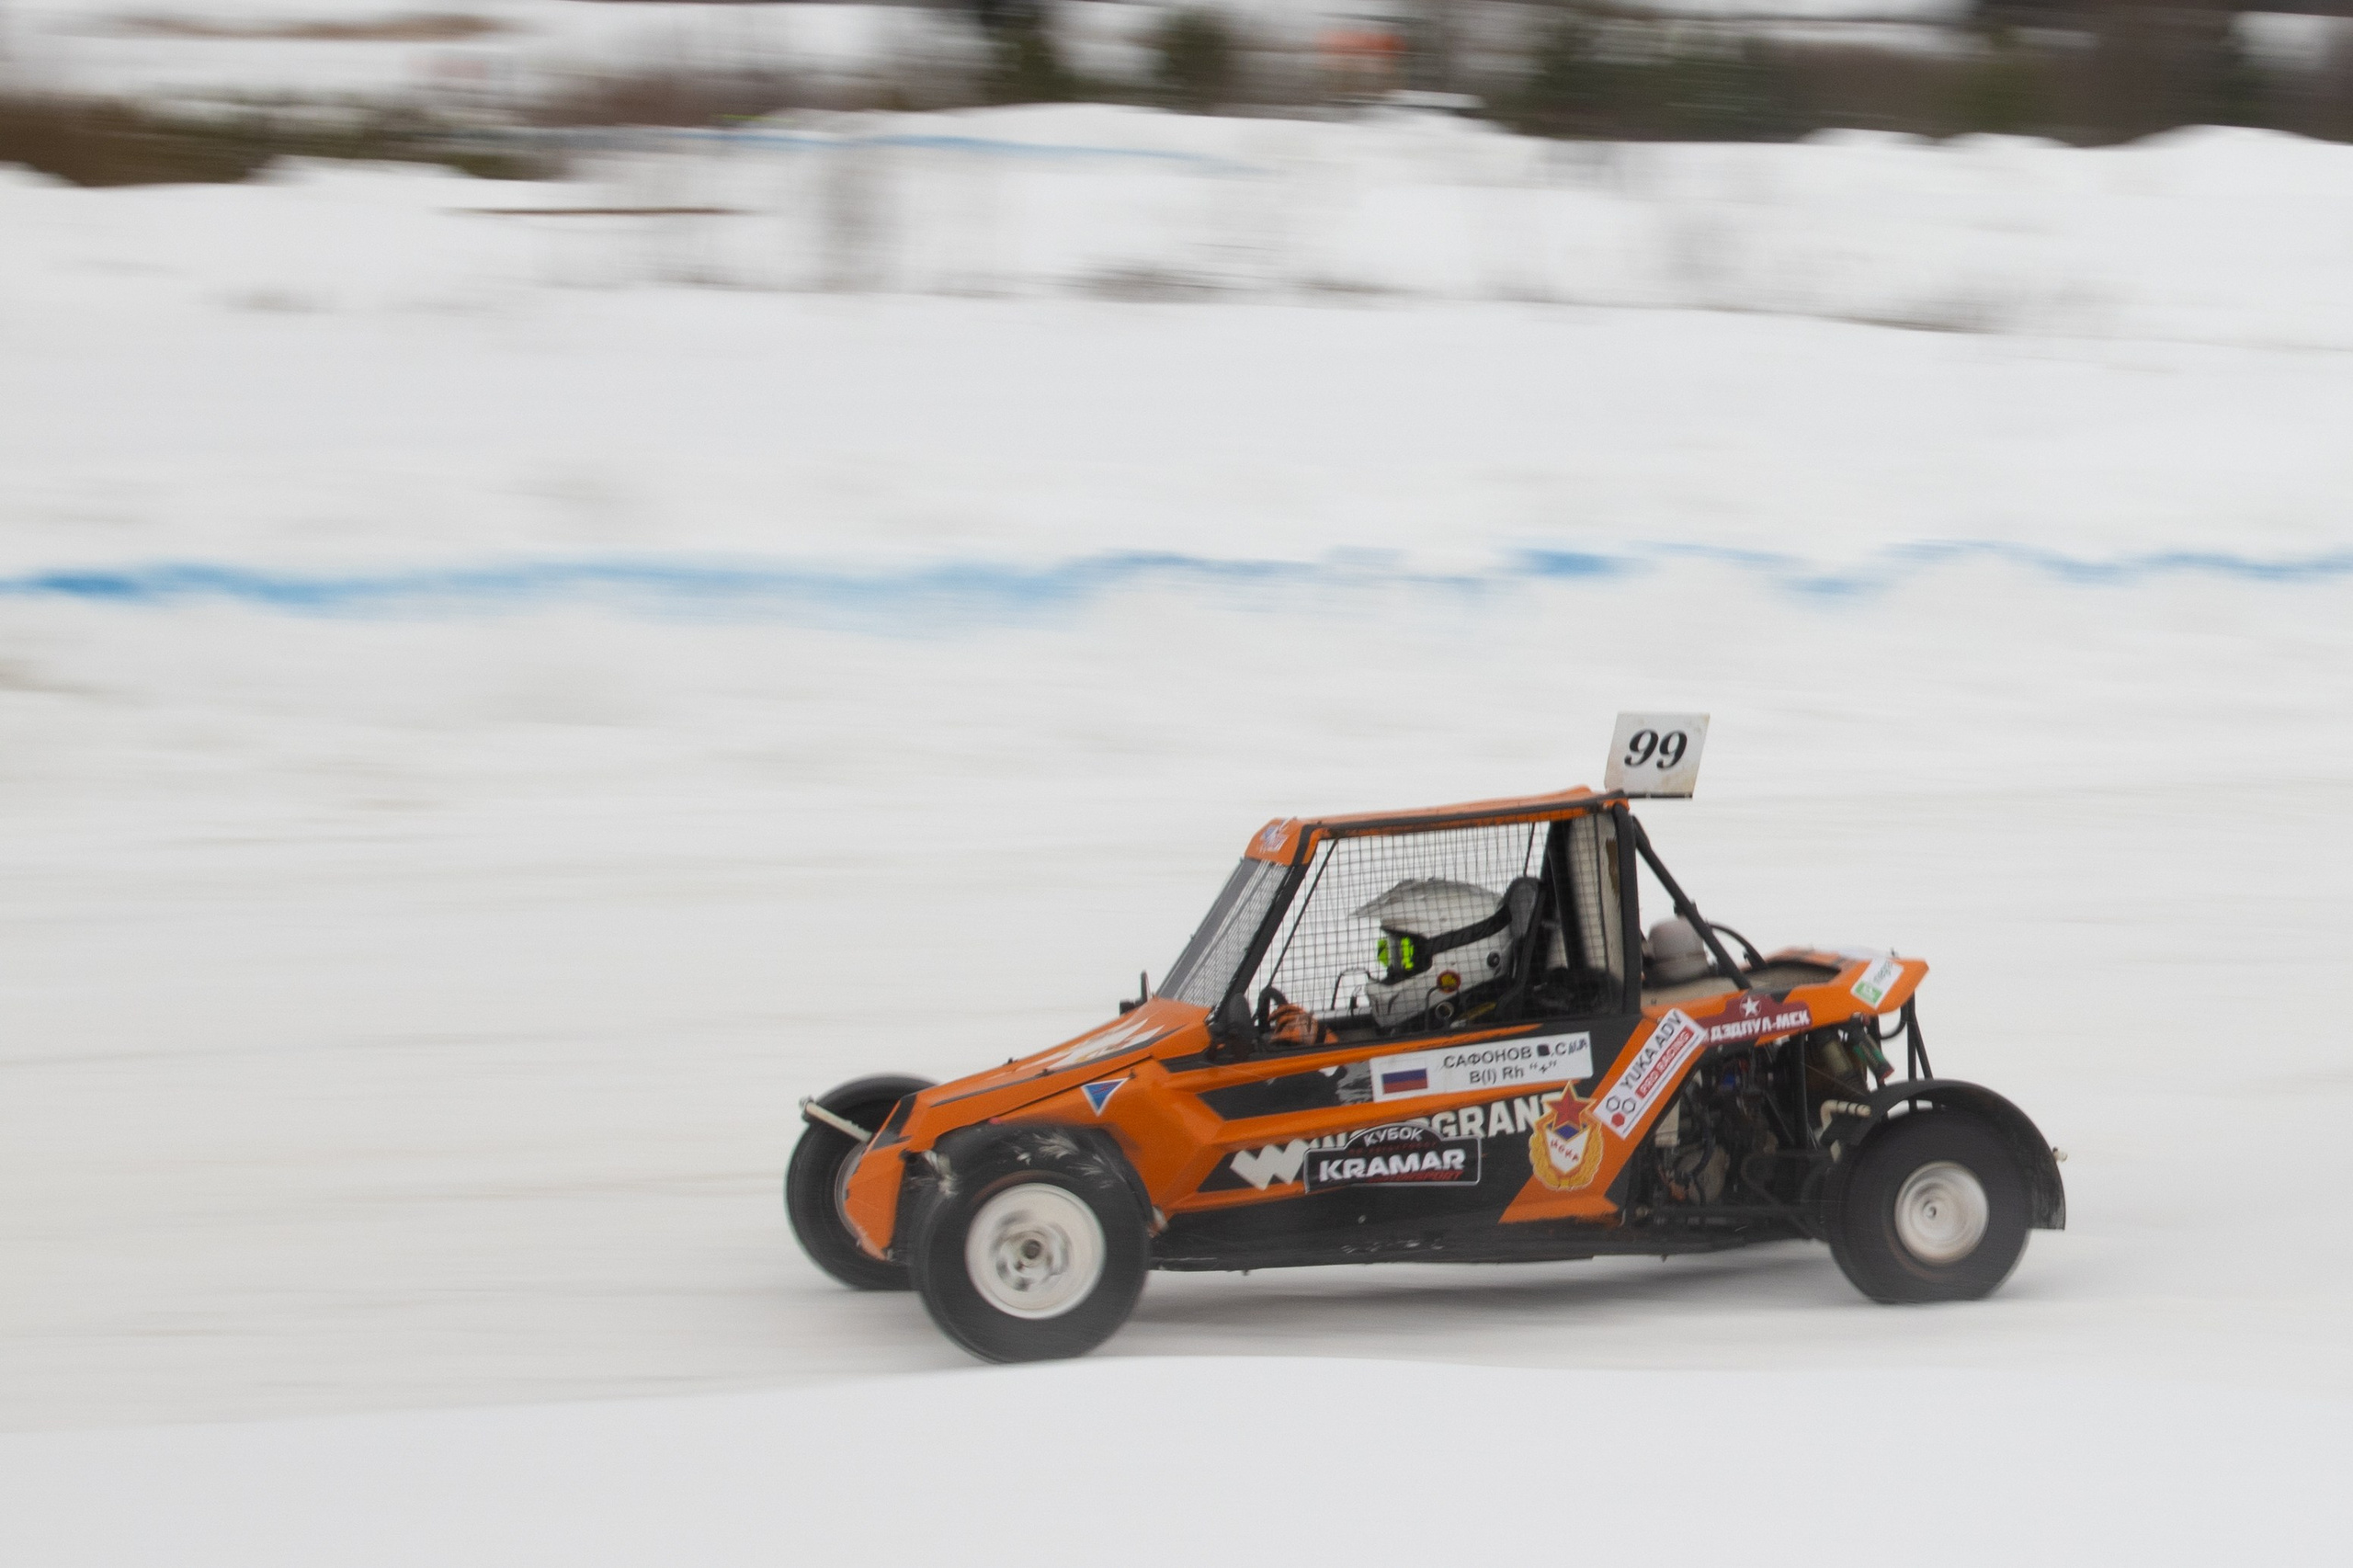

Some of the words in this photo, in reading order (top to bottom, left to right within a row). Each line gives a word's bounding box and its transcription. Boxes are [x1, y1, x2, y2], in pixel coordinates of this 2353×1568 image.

[1624, 729, 1688, 770] 99
[1443, 1046, 1532, 1069] САФОНОВ
[1620, 1048, 1658, 1089] YUKA
[1655, 1010, 1681, 1049] ADV
[1639, 1070, 1660, 1095] PRO
[1656, 1030, 1691, 1073] RACING
[1503, 1065, 1524, 1081] Rh
[1364, 1126, 1424, 1147] КУБОК
[1319, 1148, 1466, 1182] KRAMAR
